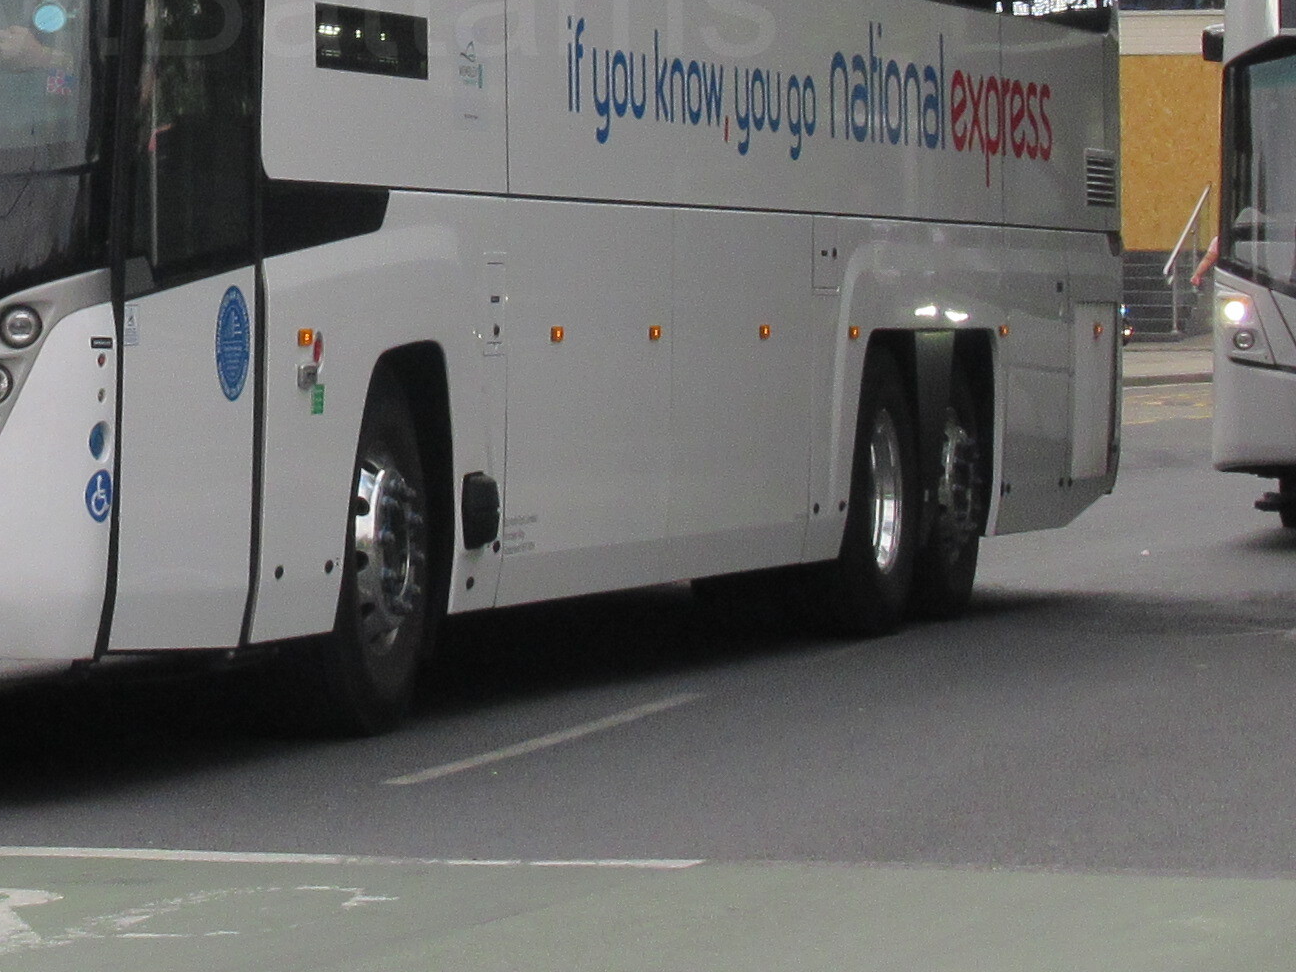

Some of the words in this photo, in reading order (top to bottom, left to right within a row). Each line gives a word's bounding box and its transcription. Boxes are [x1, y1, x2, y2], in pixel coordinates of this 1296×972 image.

[566, 15, 585, 113] if
[592, 47, 647, 145] you
[734, 66, 782, 156] you
[787, 74, 817, 161] go
[830, 21, 946, 150] national
[951, 69, 1053, 188] express
